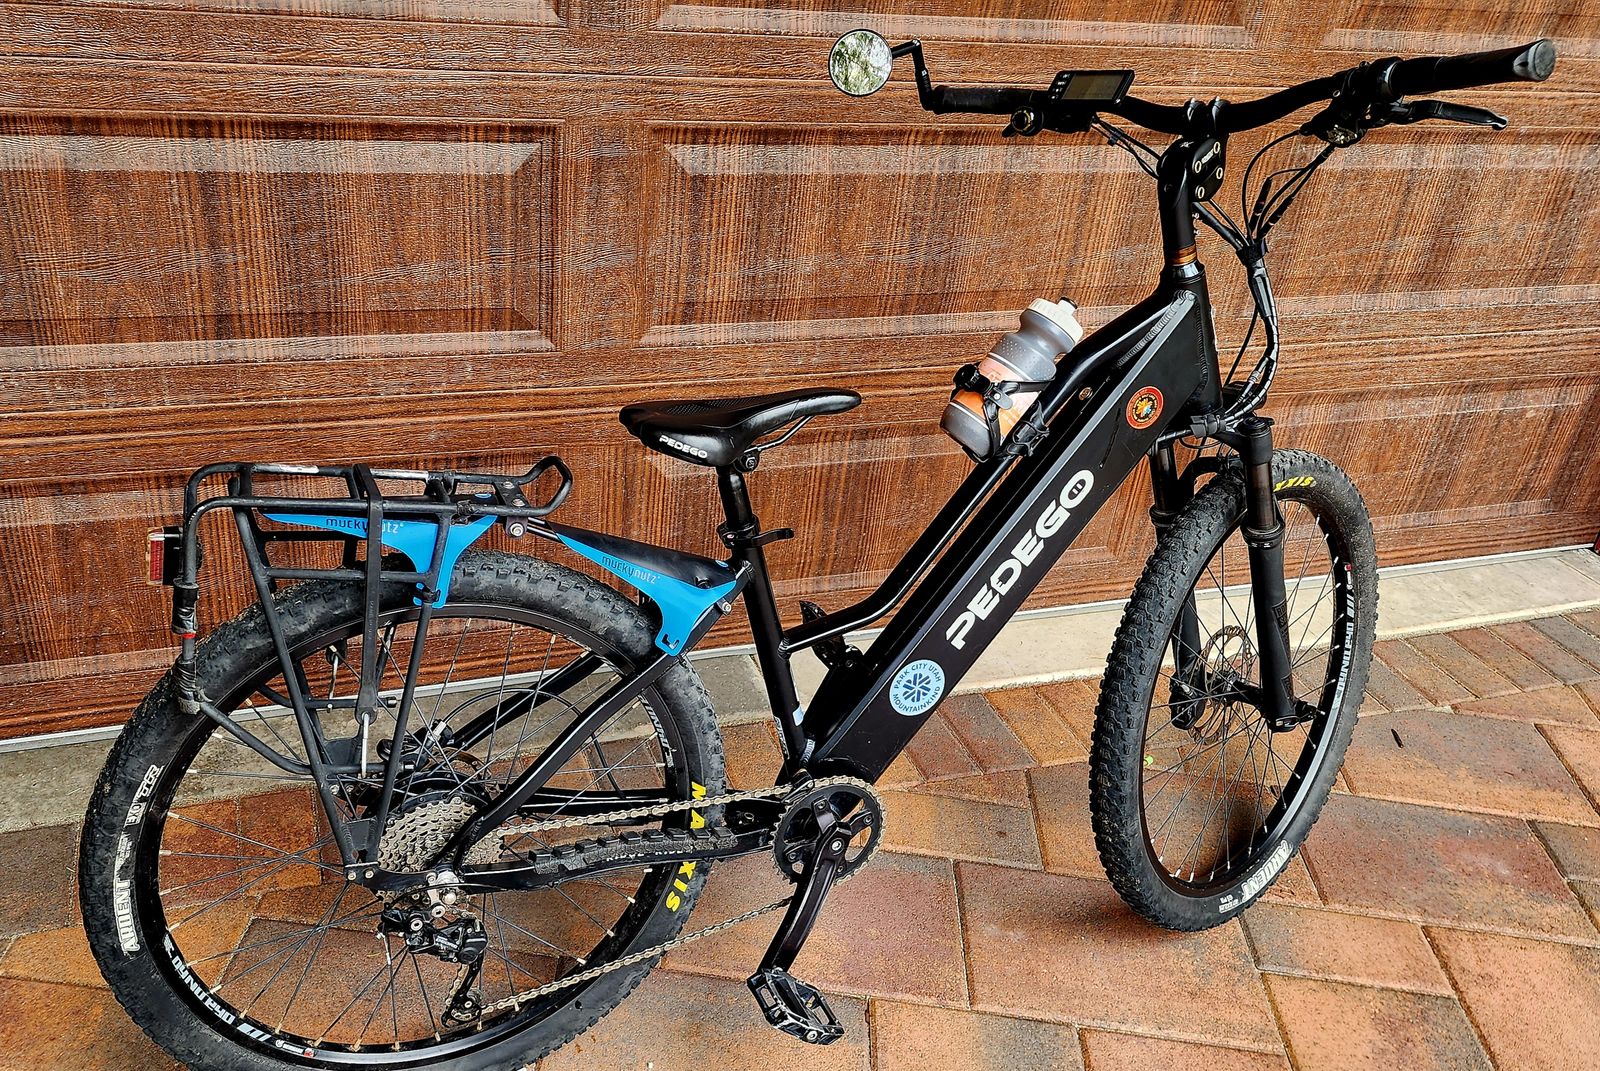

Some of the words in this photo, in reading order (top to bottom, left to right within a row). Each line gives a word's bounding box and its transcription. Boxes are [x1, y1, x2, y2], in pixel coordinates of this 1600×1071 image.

[659, 434, 708, 459] PEDEGO
[945, 468, 1095, 650] PEDEGO
[892, 686, 941, 713] MOUNTAINKIND
[894, 670, 910, 689] PARK
[911, 663, 927, 671] CITY
[928, 664, 941, 682] UTAH
[666, 781, 707, 912] MAXIS
[113, 877, 140, 951] ARDENT
